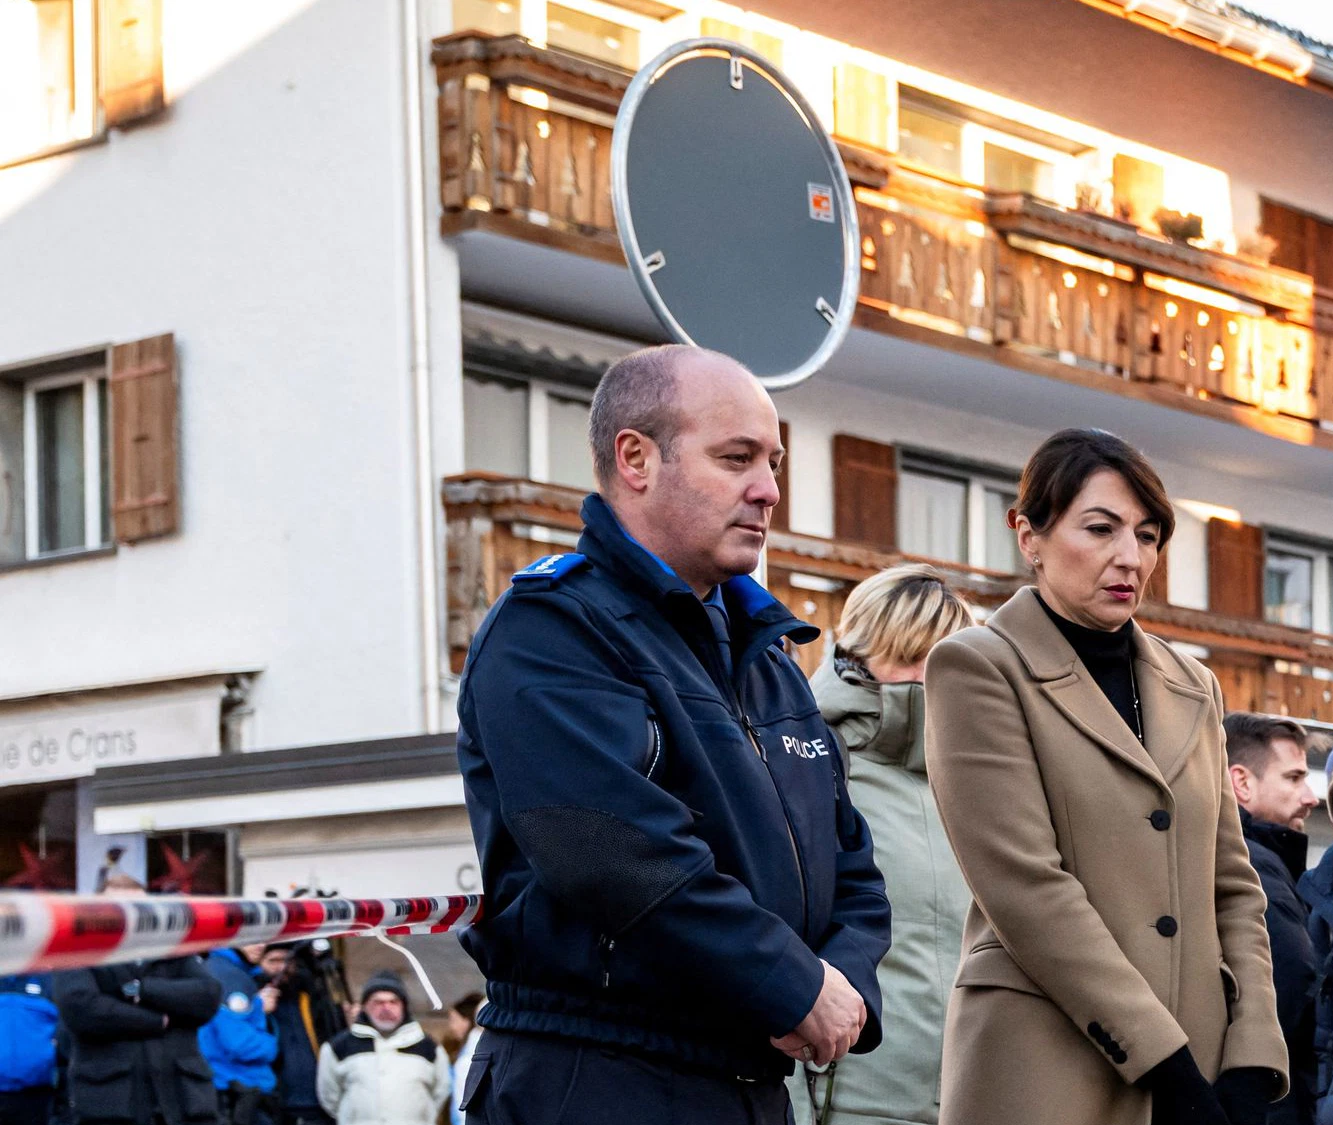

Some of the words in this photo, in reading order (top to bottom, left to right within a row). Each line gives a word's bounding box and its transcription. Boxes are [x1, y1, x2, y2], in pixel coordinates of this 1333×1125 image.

[28, 734, 60, 767] de
[67, 728, 137, 762] Crans
[782, 735, 829, 759] POLICE
